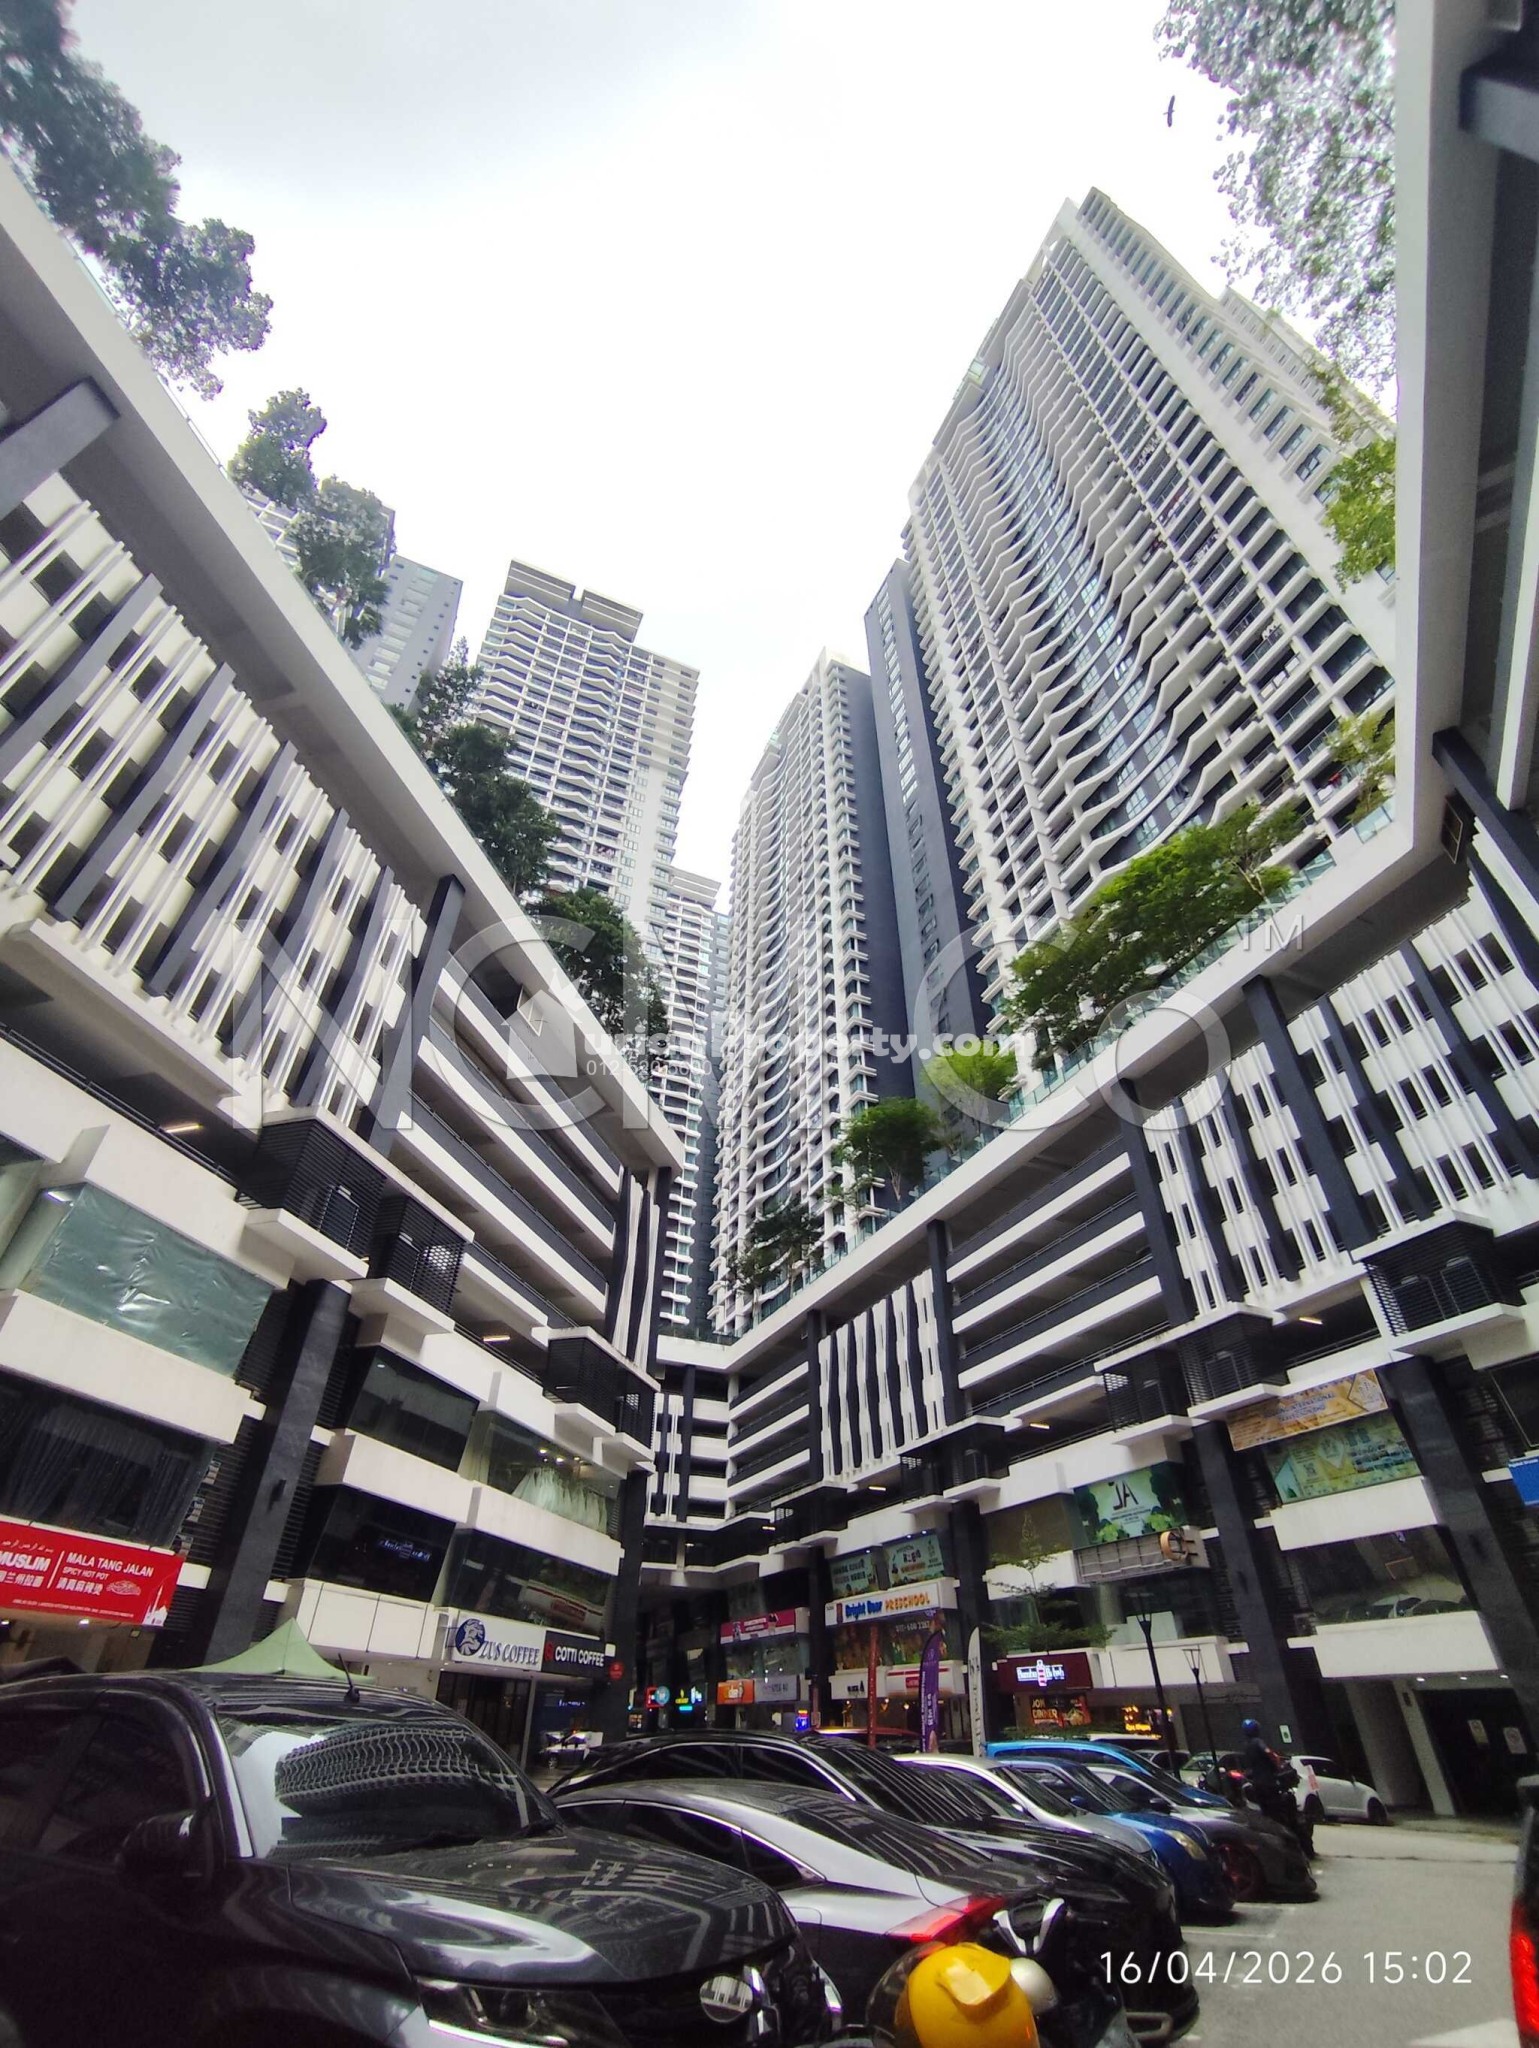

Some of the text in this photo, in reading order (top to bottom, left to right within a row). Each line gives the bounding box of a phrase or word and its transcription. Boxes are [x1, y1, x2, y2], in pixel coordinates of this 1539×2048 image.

[0, 1550, 51, 1572] MUSLIM
[66, 1552, 155, 1578] MALA TANG JALAN
[62, 1566, 109, 1580] SPICY HOT POT
[885, 1591, 931, 1611] PRESCHOOL
[478, 1639, 541, 1666] ZUS COFFEE
[555, 1645, 605, 1668] COTTI COFFEE
